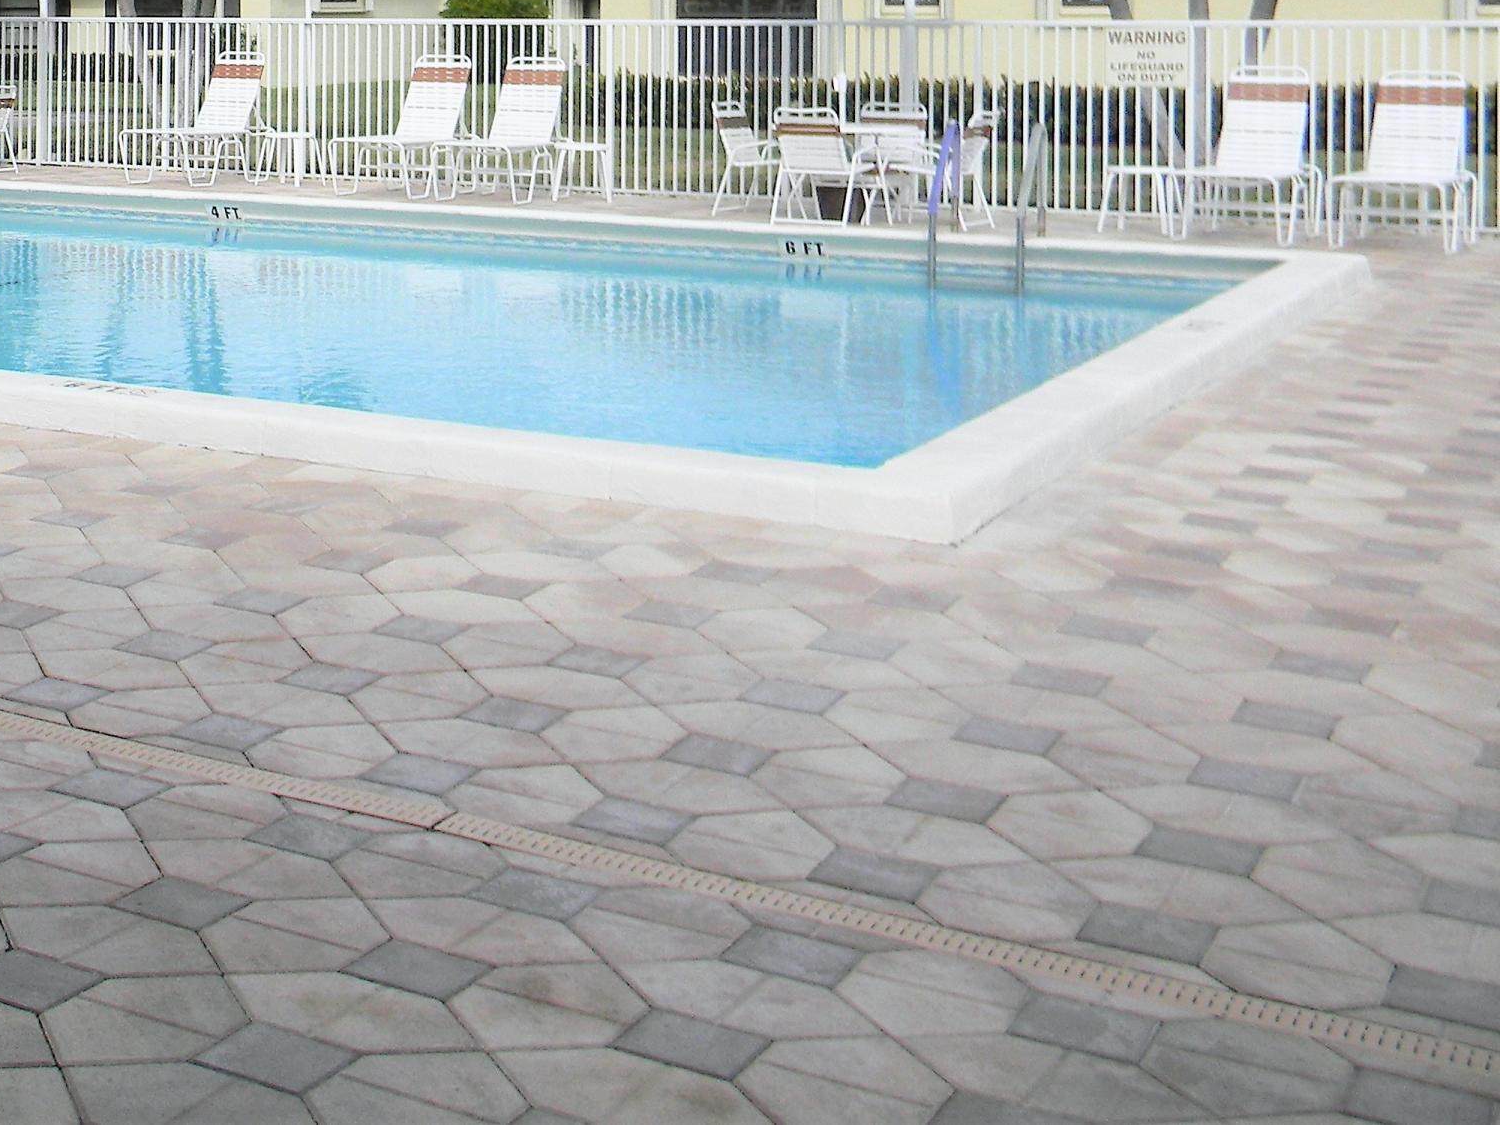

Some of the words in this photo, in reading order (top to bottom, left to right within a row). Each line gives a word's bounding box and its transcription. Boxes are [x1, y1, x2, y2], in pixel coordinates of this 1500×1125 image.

[1108, 30, 1186, 45] WARNING
[1136, 50, 1156, 60] NO
[1110, 62, 1184, 72] LIFEGUARD
[1117, 74, 1136, 82] ON
[1140, 74, 1175, 82] DUTY
[211, 206, 220, 218] 4
[785, 241, 796, 255] 6
